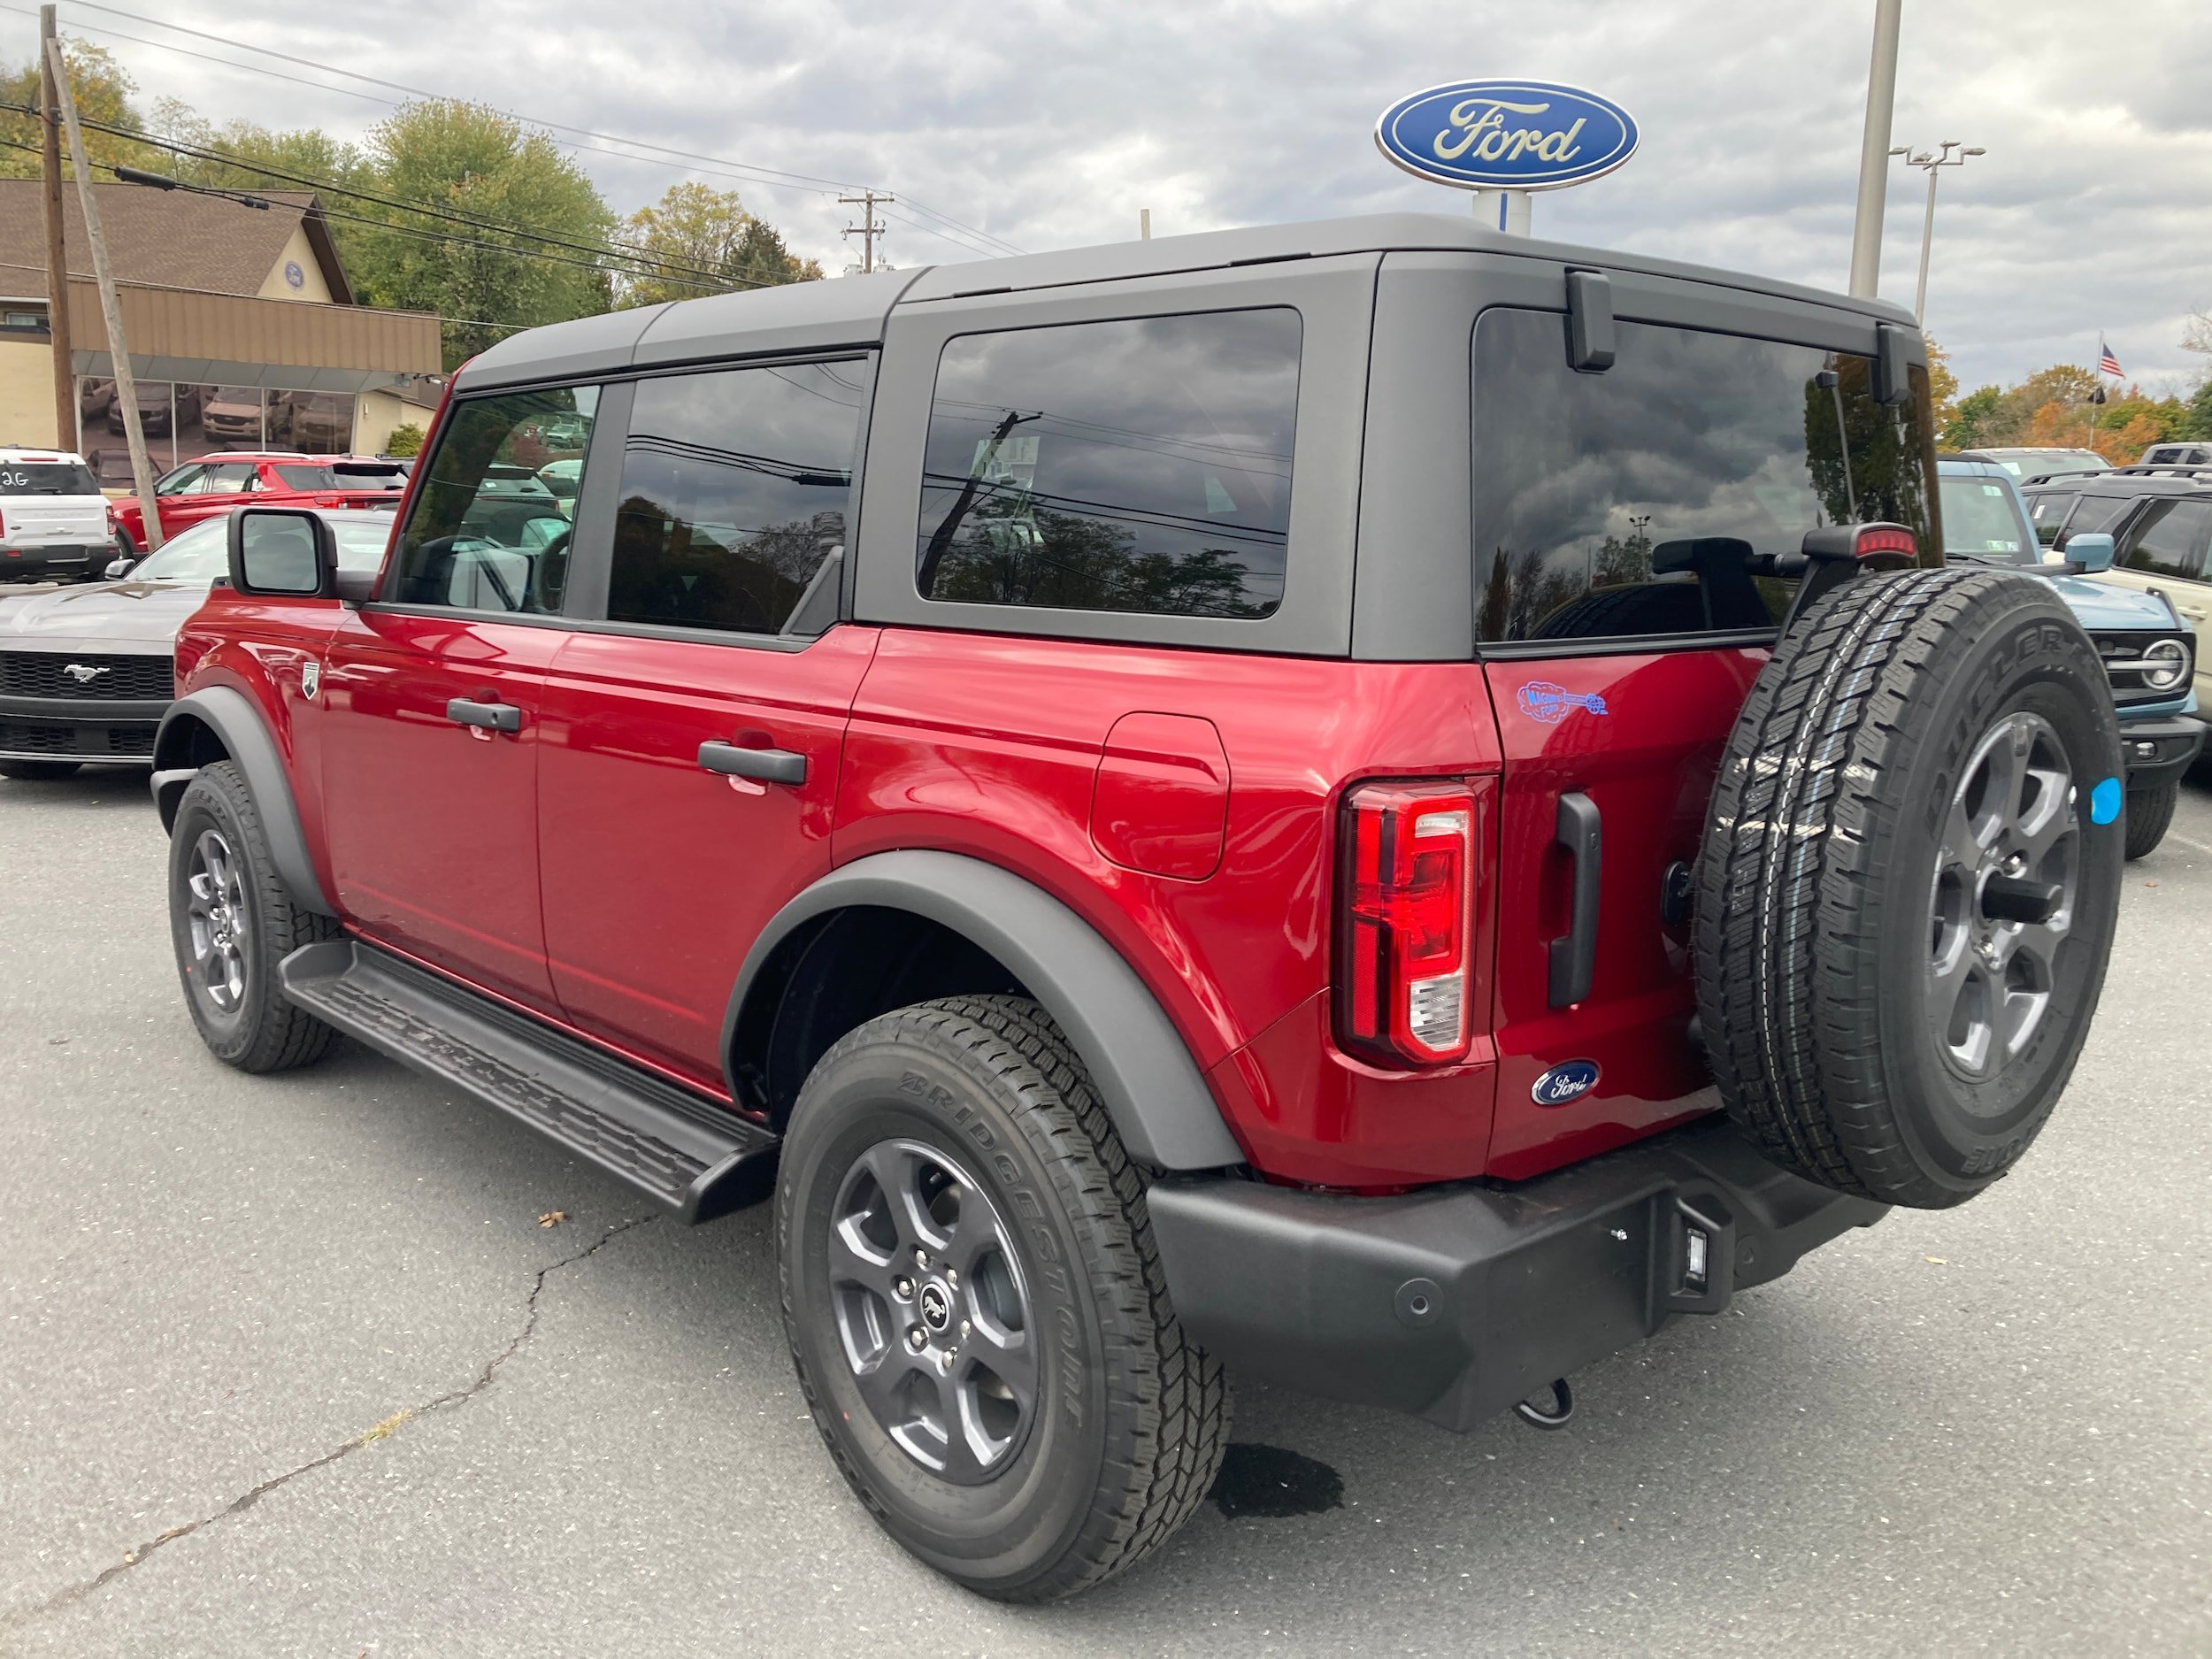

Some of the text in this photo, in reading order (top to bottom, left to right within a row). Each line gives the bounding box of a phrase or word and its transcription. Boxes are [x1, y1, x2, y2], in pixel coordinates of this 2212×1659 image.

[1432, 97, 1587, 163] Ford
[1550, 1073, 1587, 1098] Ford
[896, 1070, 1086, 1437] BRIDGESTONE
